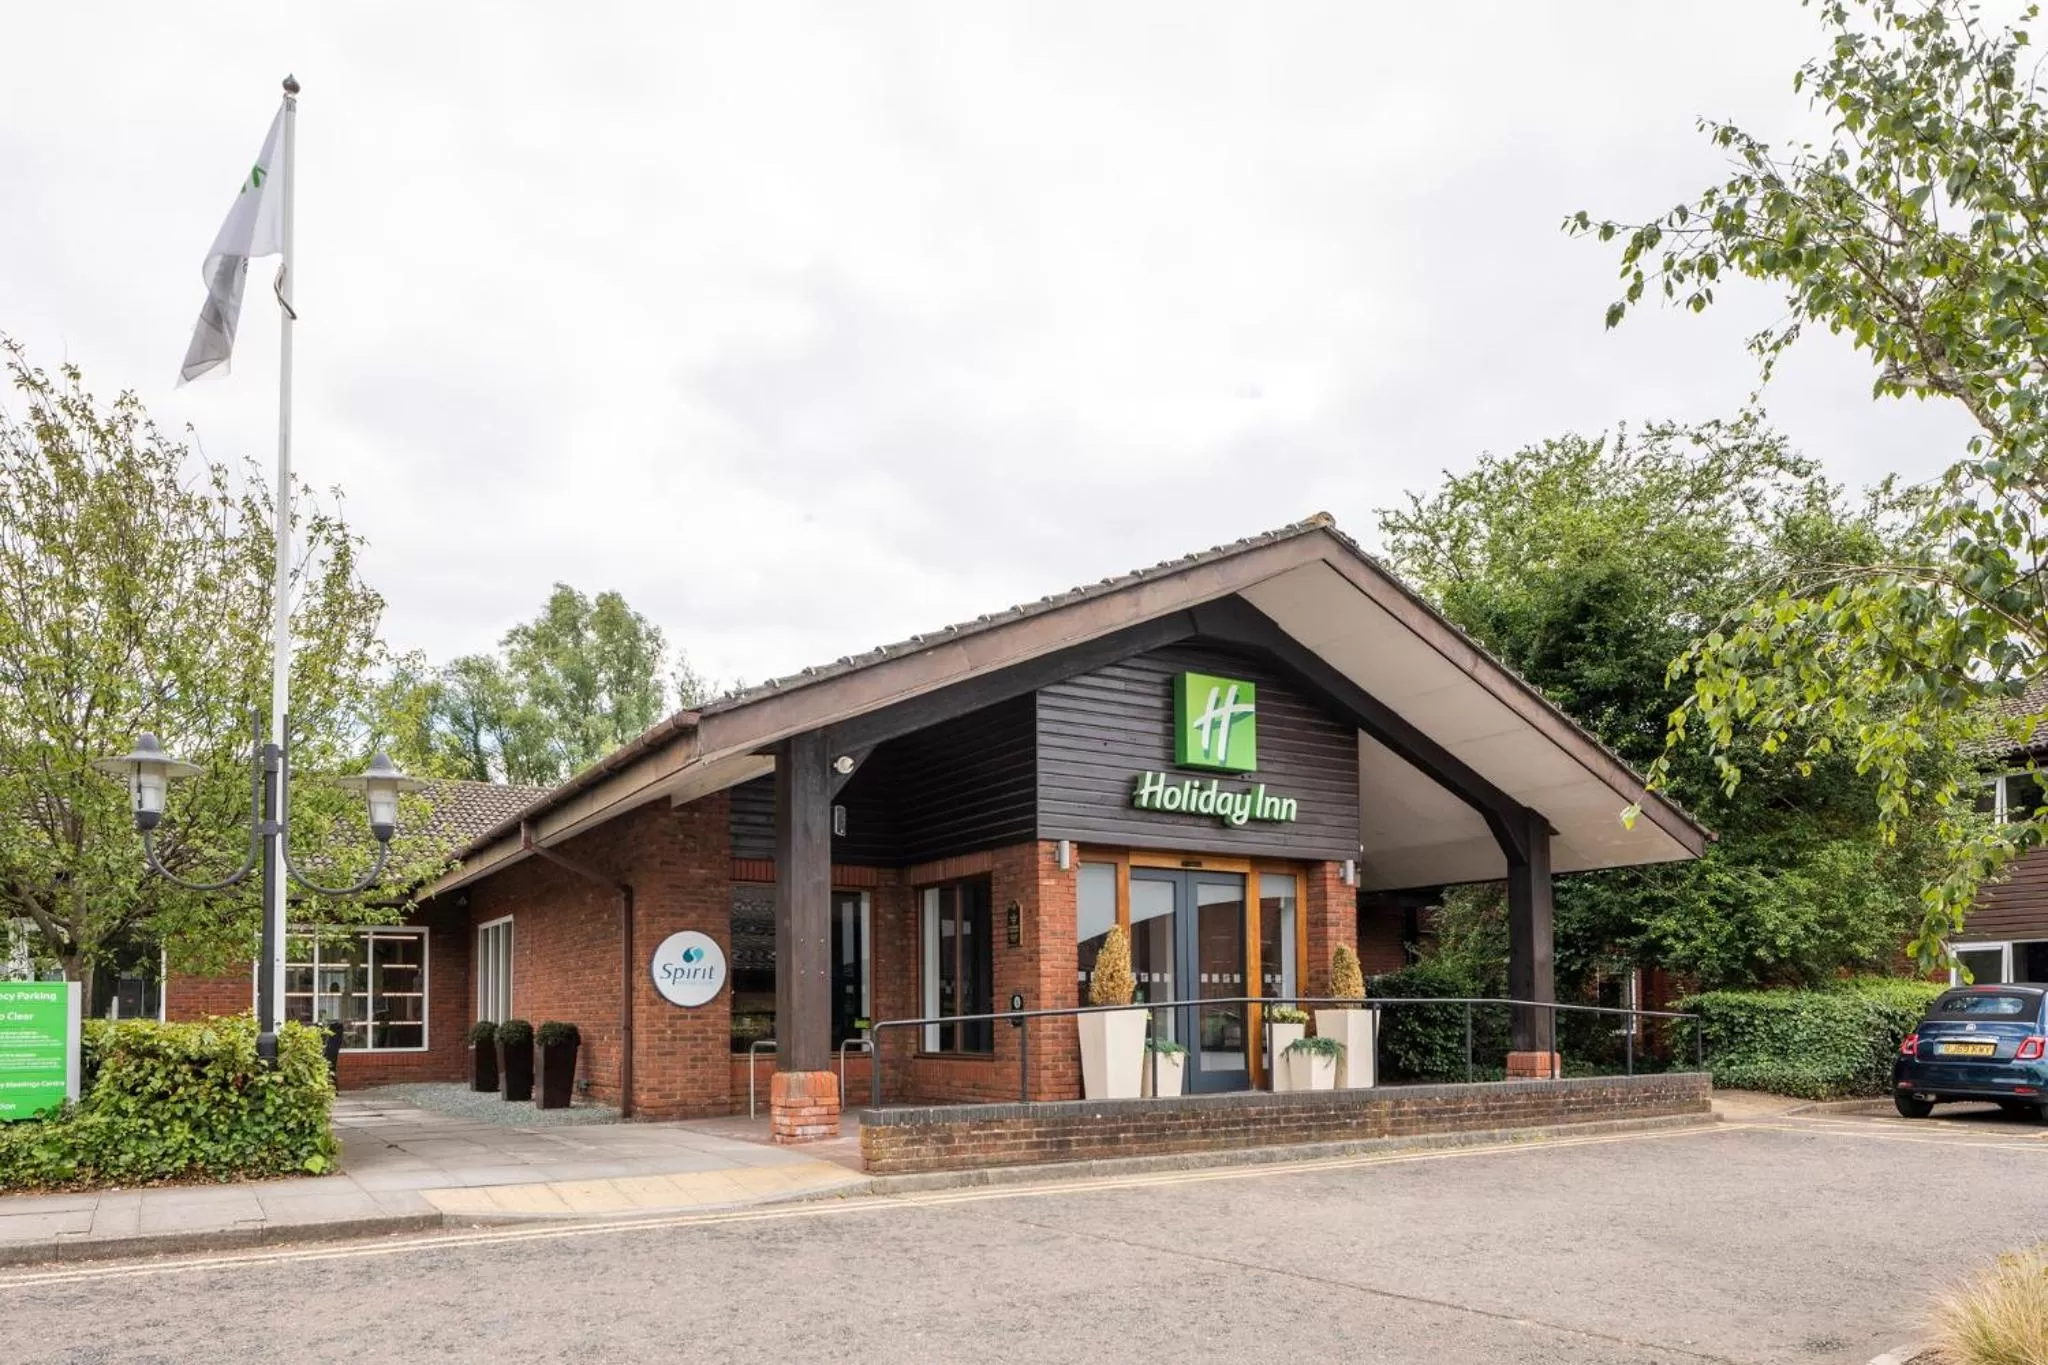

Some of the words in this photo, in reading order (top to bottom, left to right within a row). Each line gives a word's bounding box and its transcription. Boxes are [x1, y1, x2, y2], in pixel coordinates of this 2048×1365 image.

[1137, 771, 1252, 825] Holiday
[1255, 783, 1298, 822] Inn
[660, 963, 716, 985] Spirit
[17, 992, 57, 1002] Parking
[7, 1012, 34, 1021] Clear
